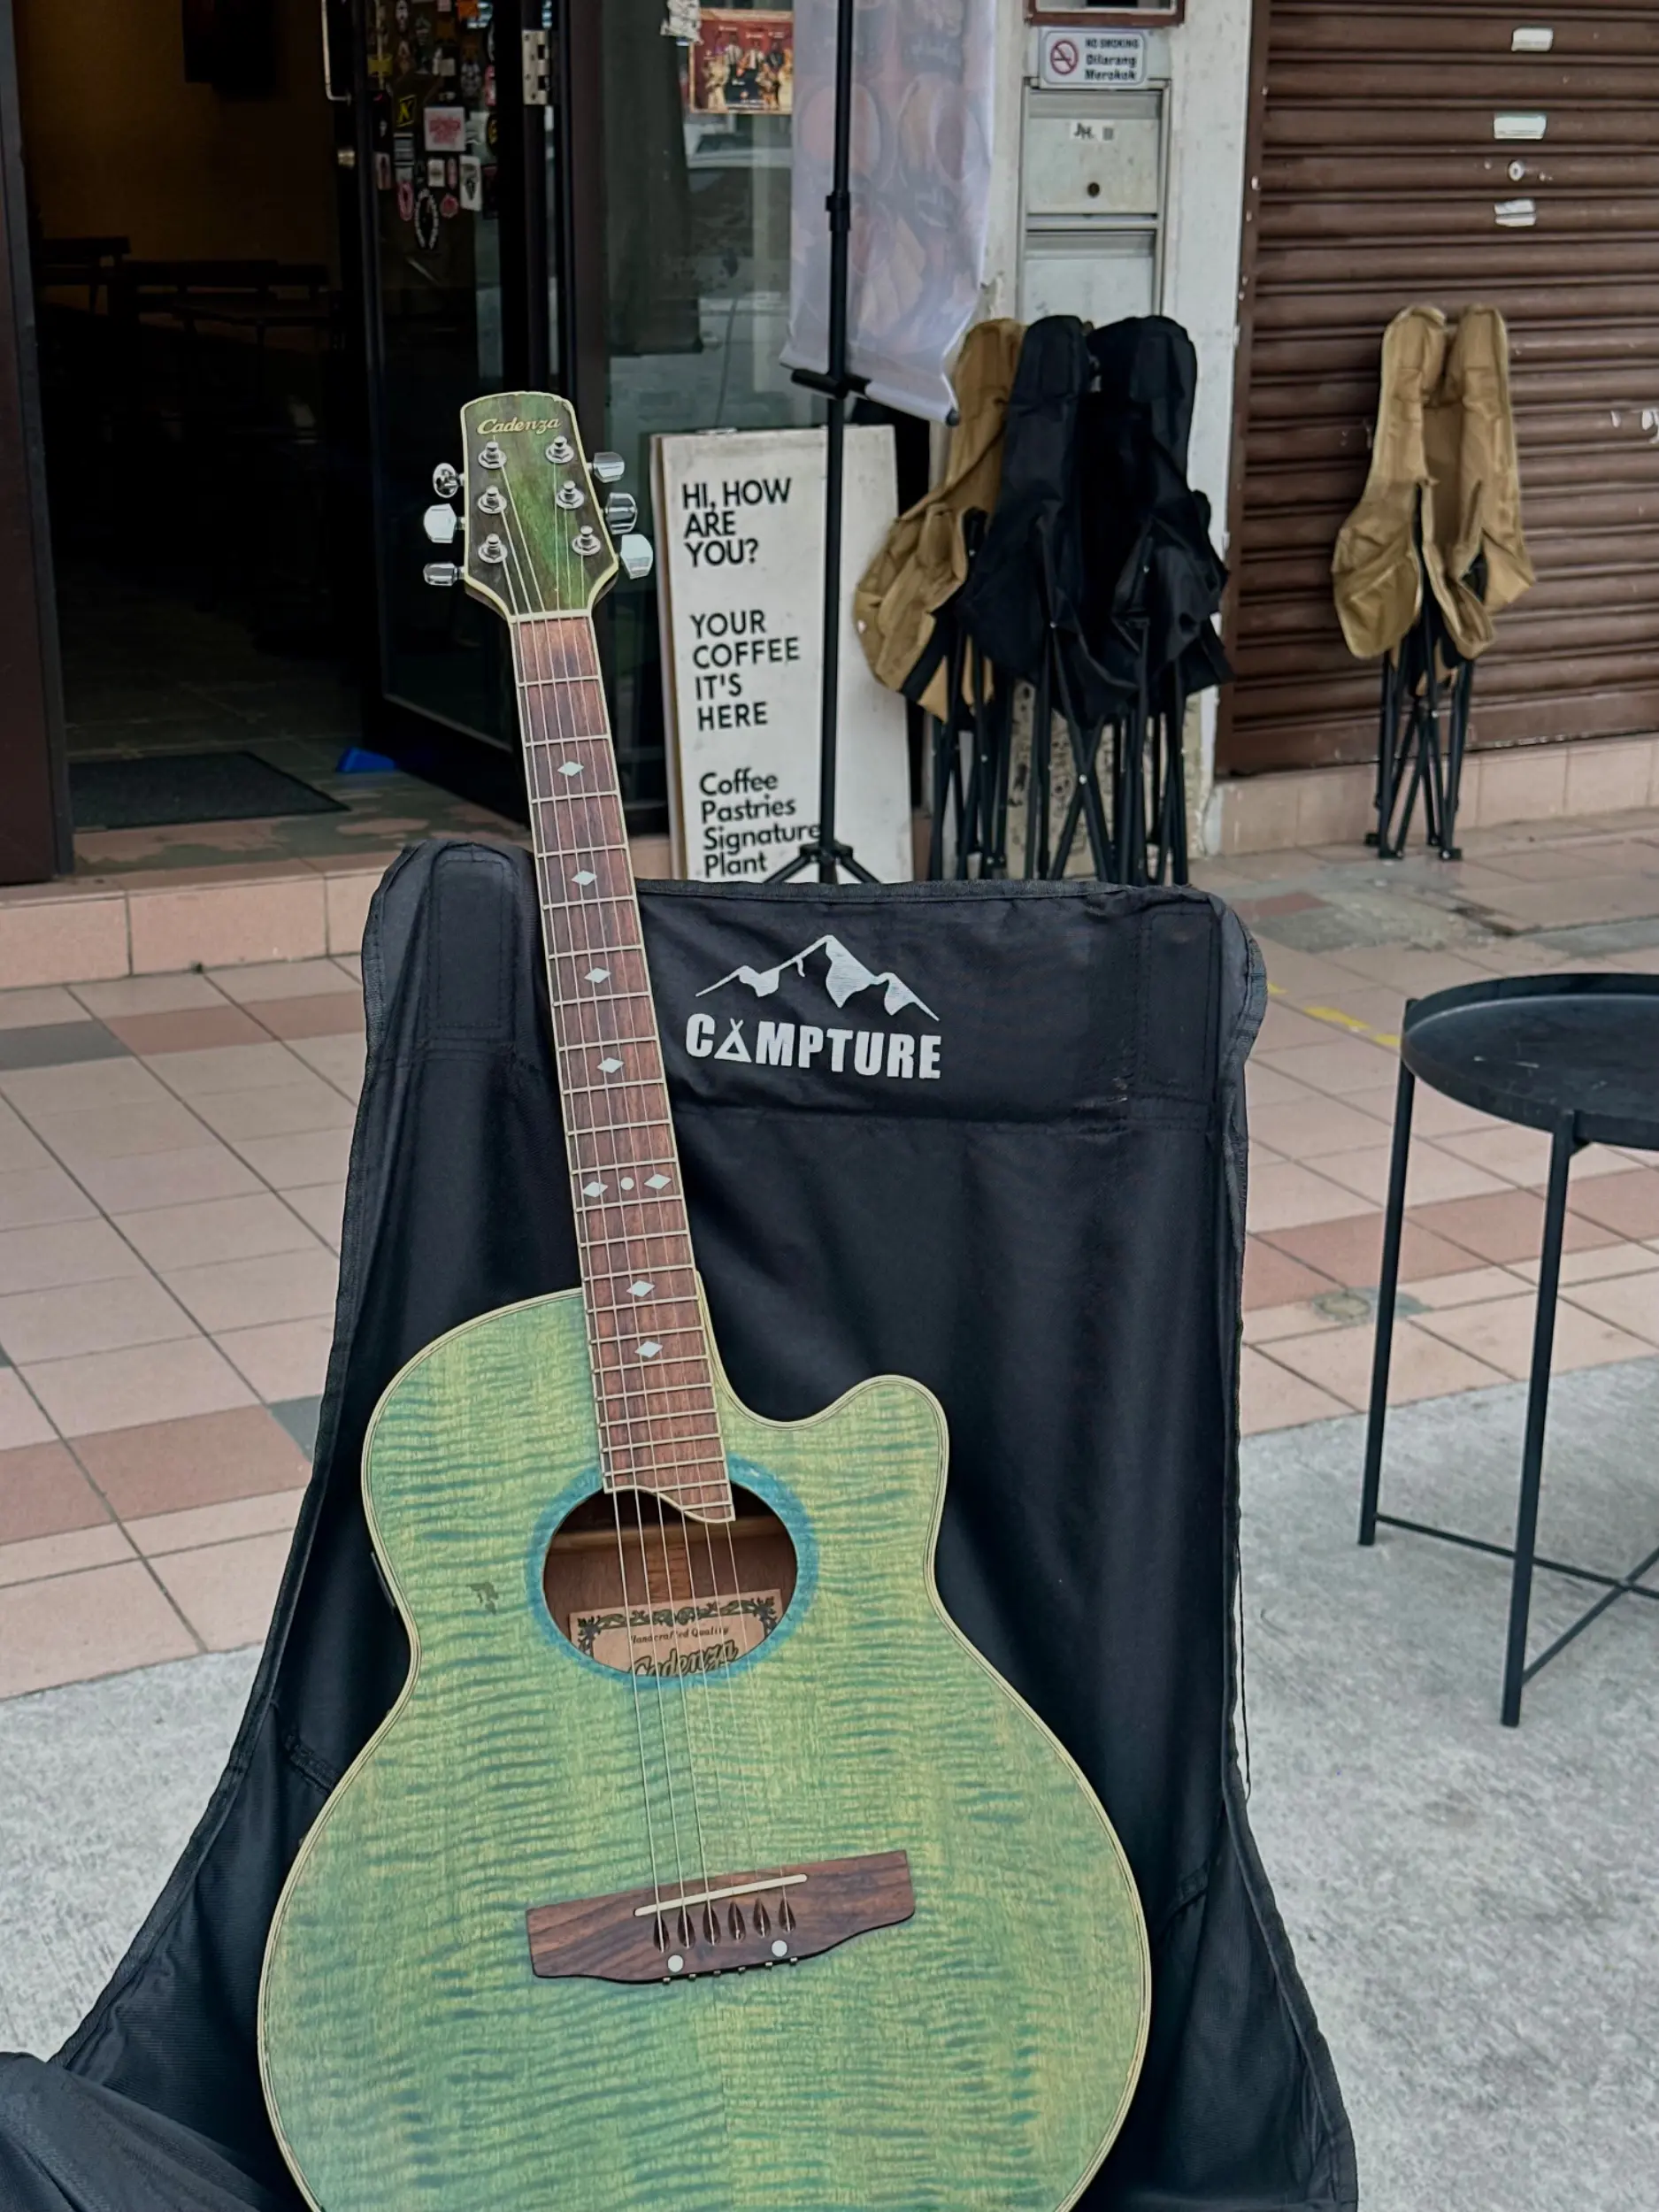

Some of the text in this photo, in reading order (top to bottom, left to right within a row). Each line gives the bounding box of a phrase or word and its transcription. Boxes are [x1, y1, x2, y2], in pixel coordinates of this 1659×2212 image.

[1100, 38, 1140, 48] SMOKING
[1086, 54, 1137, 68] Dilarang
[477, 417, 562, 434] Cadenza
[682, 477, 791, 513] HI, HOW
[683, 510, 736, 539] ARE
[684, 537, 759, 567] YOU?
[689, 609, 767, 639] YOUR
[692, 636, 801, 670] COFFEE
[695, 672, 742, 702] IT'S
[697, 700, 768, 732] HERE
[699, 765, 779, 796] Coffee
[701, 793, 796, 825] Pastries
[703, 821, 821, 856] Signature
[704, 849, 768, 879] Plant
[691, 1625, 729, 1638] Quality
